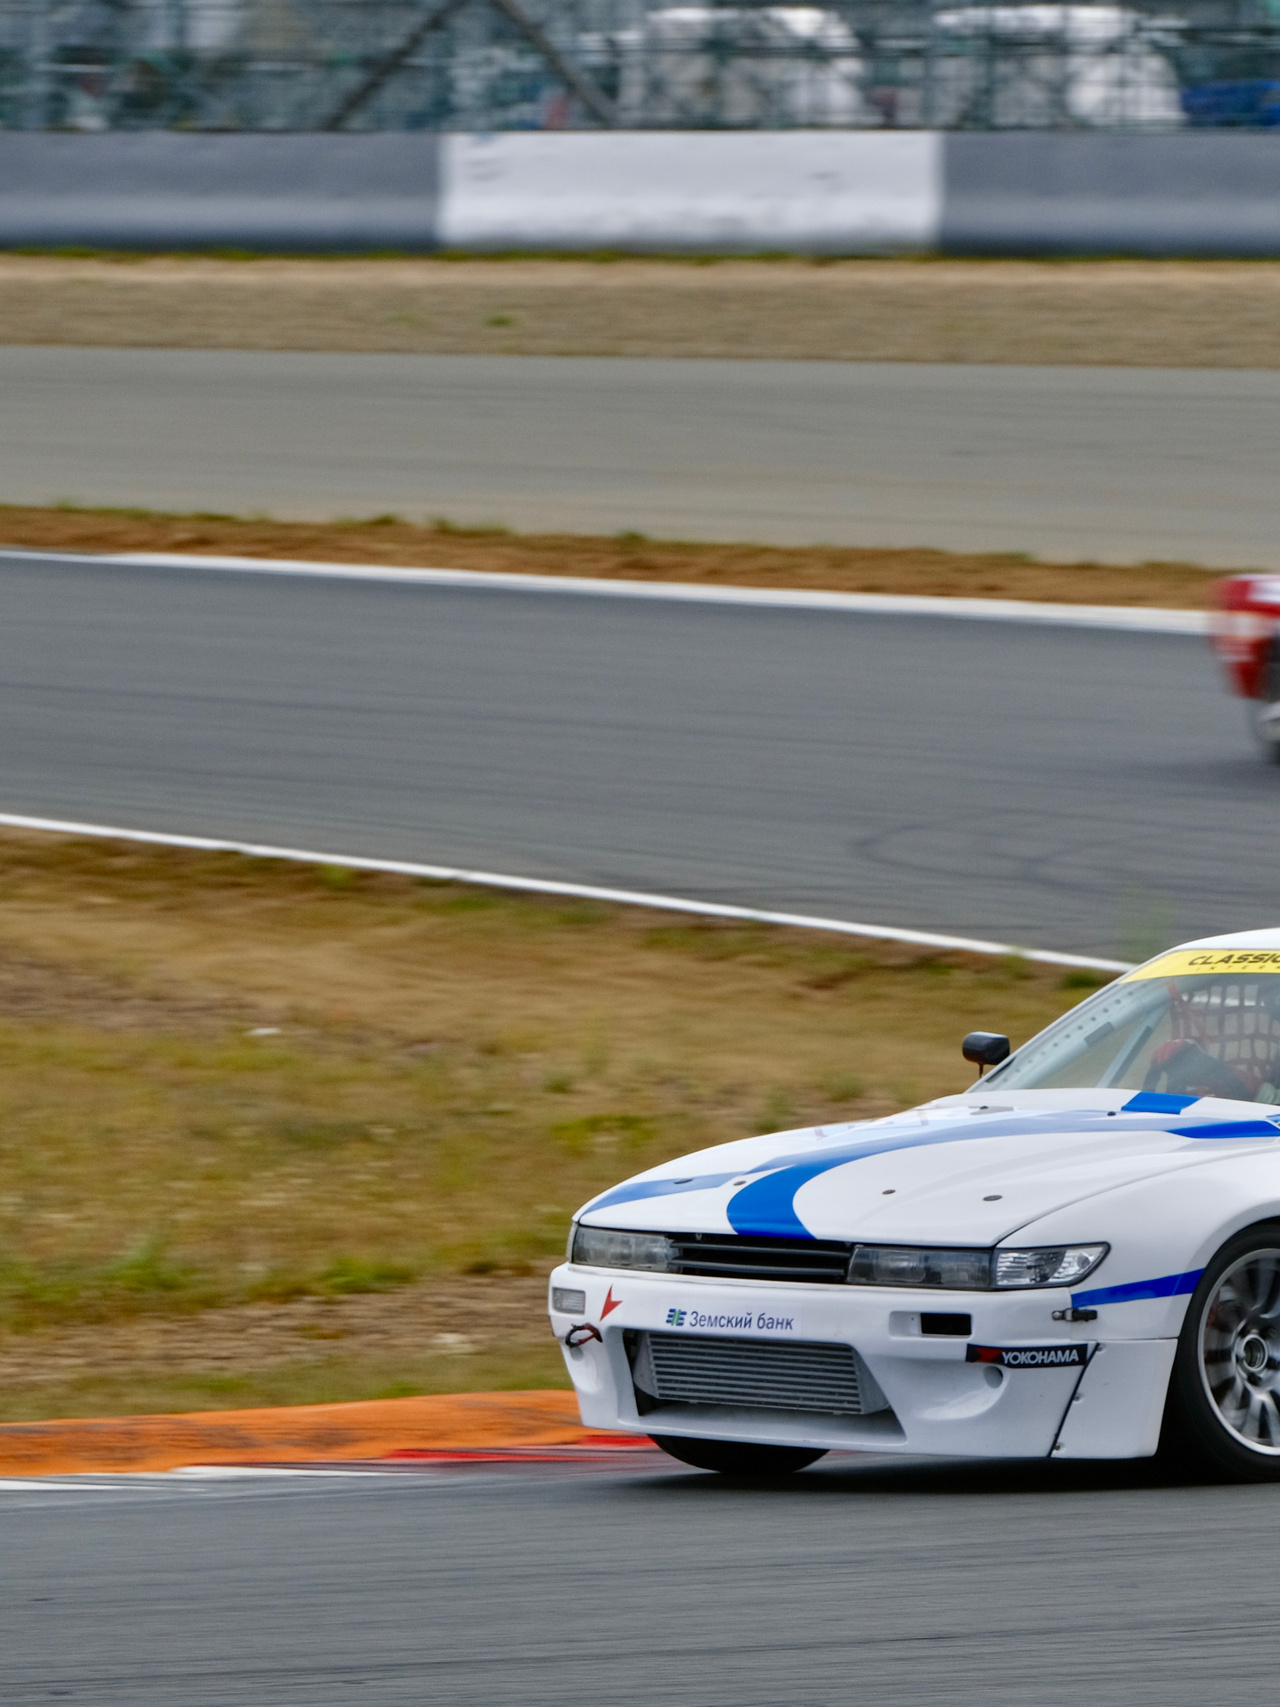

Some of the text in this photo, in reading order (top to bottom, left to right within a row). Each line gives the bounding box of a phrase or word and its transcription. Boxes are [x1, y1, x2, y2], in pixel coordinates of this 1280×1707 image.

[689, 1306, 795, 1330] Земский банк
[1002, 1348, 1080, 1365] YOKOHAMA
